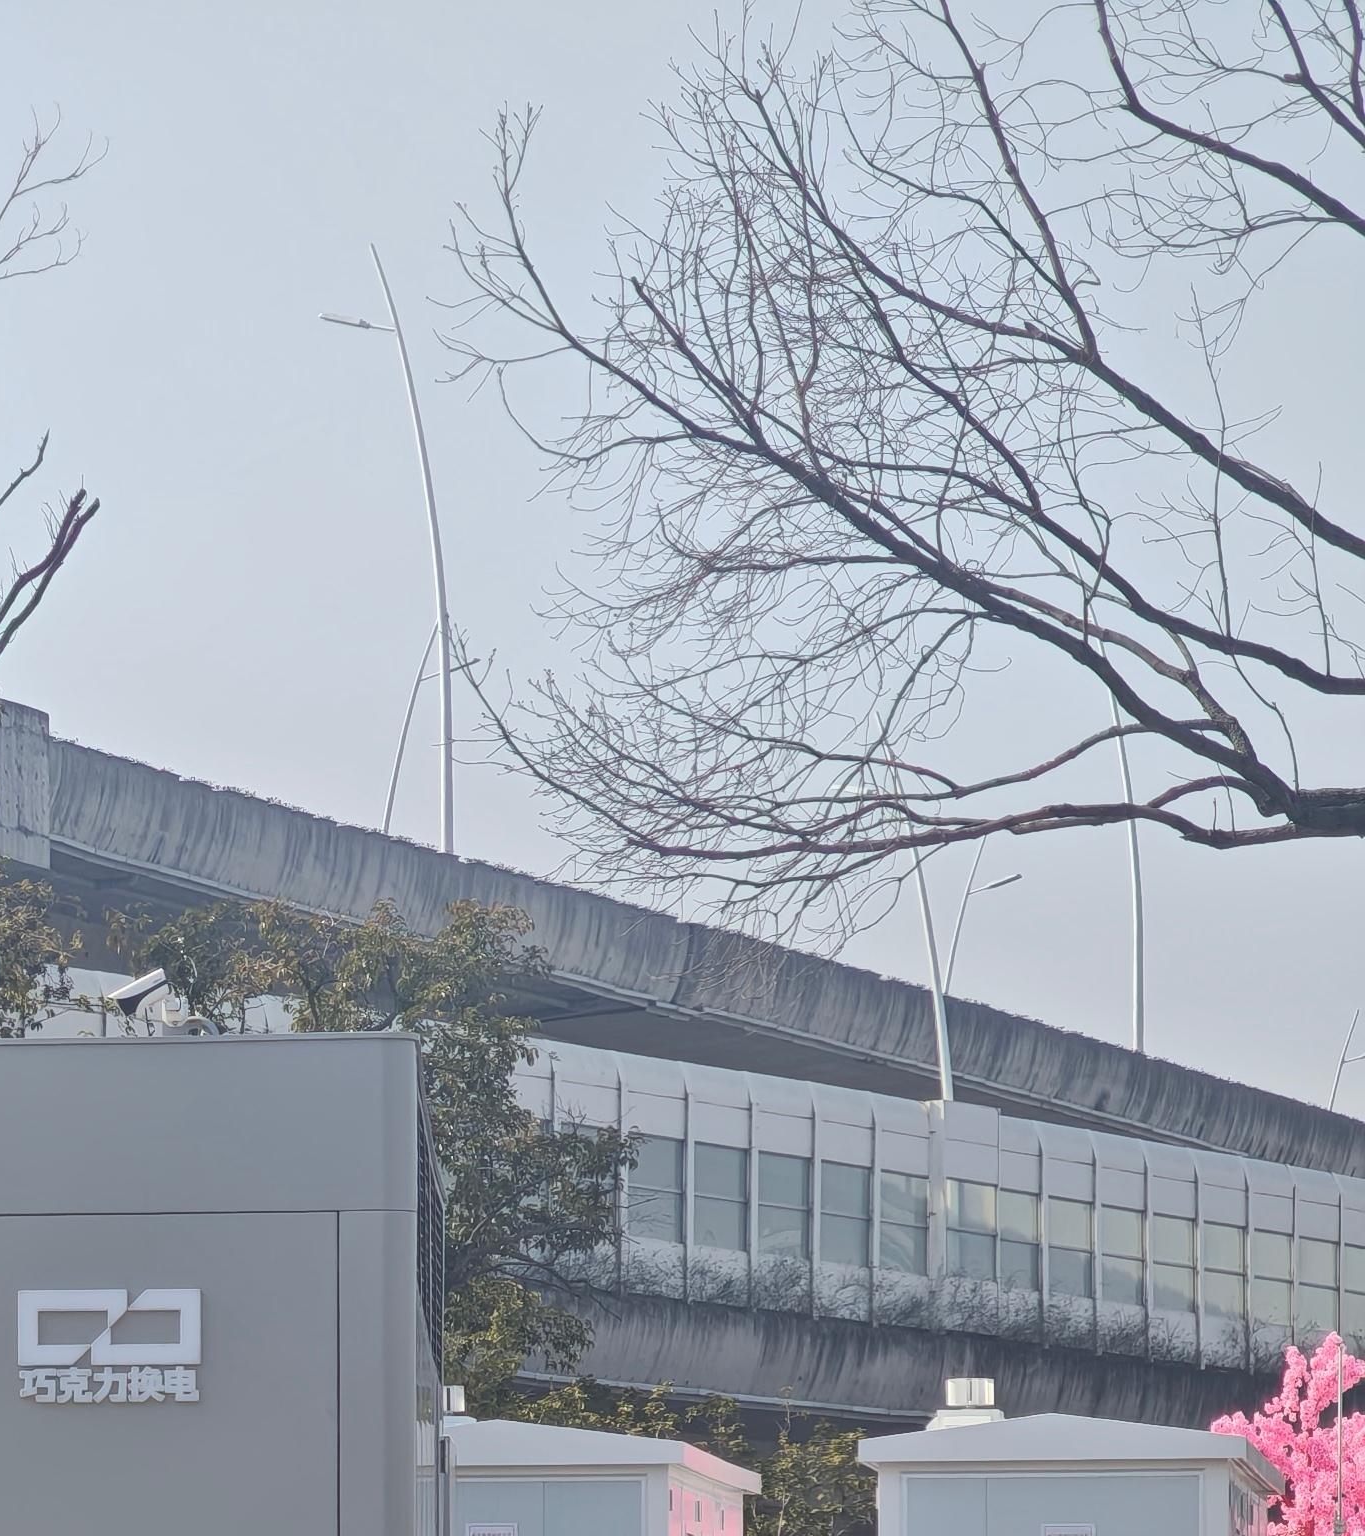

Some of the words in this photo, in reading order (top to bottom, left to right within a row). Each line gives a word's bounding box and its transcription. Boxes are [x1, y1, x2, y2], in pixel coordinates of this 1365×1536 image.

[18, 1366, 200, 1403] 巧克力换电
